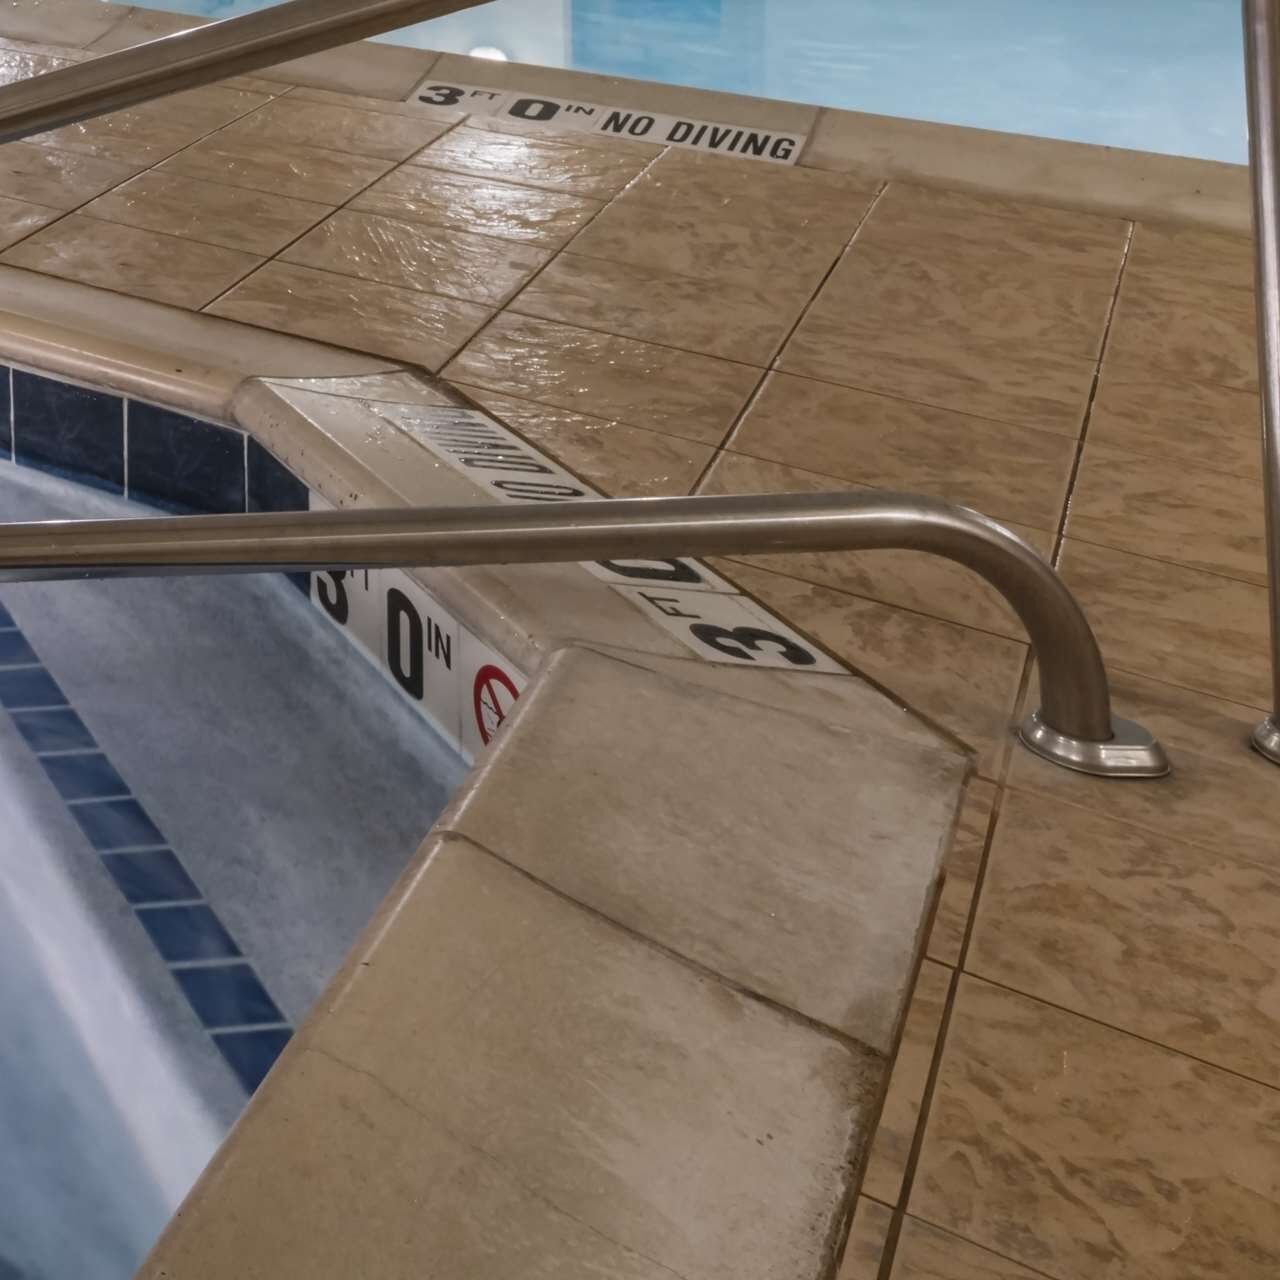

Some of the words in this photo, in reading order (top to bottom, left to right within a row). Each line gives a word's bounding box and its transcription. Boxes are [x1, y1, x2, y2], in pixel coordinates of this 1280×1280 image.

[418, 85, 465, 106] 3
[470, 90, 502, 101] FT
[507, 98, 561, 121] 0
[564, 105, 595, 116] IN
[600, 111, 656, 137] NO
[666, 121, 795, 160] DIVING
[638, 591, 702, 619] FT
[387, 587, 424, 701] 0
[427, 615, 451, 670] IN
[689, 623, 817, 665] 3
